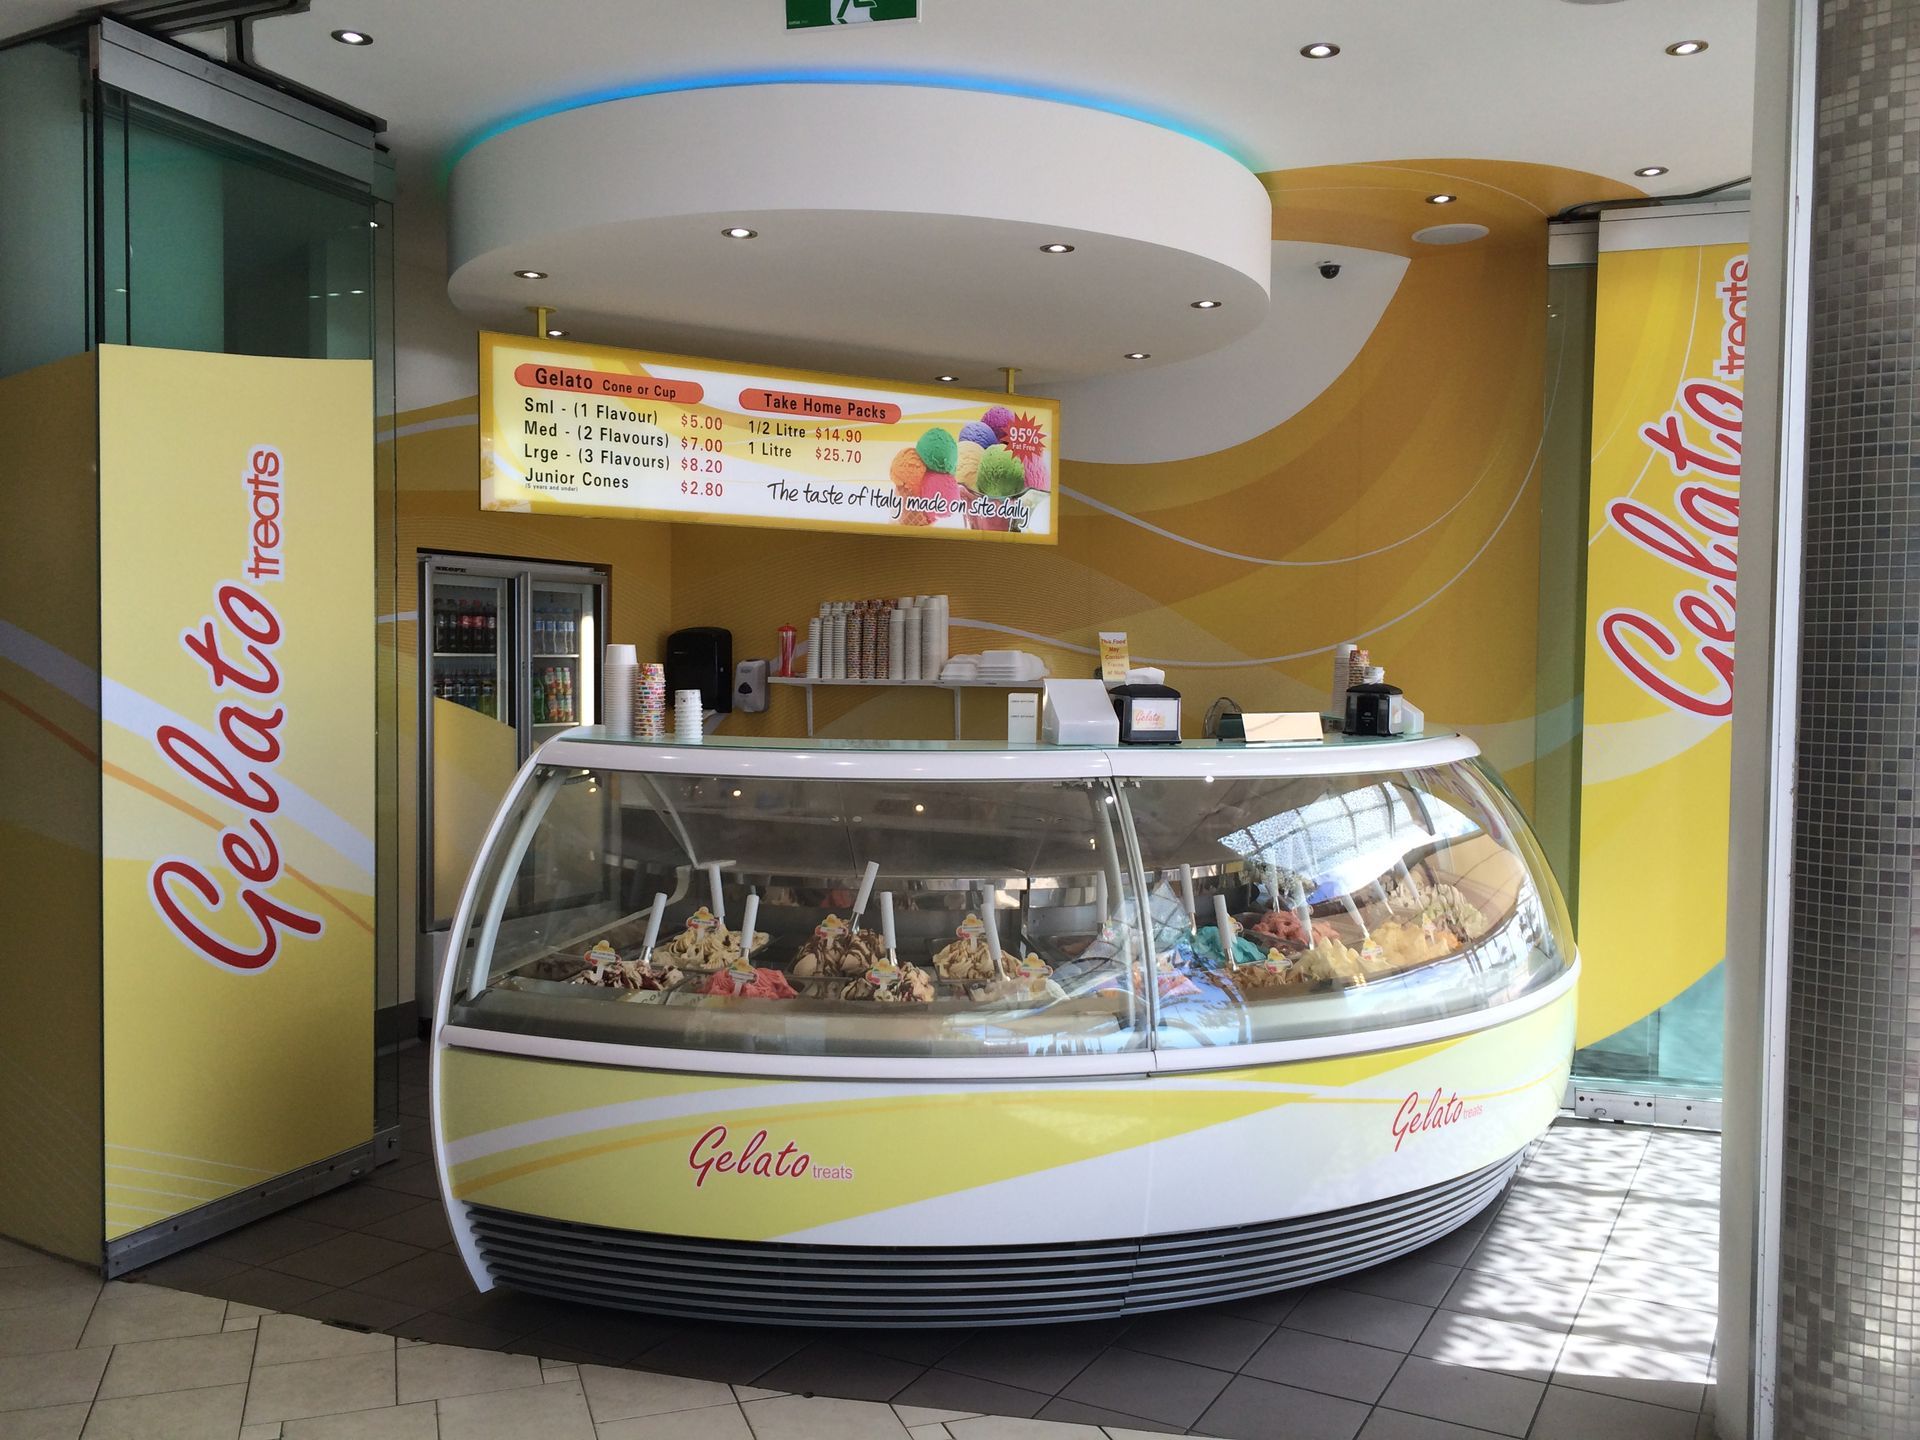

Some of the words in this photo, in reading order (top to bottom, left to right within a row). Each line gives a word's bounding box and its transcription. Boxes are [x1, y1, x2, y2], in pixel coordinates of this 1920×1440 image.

[535, 368, 593, 390] Gelato
[602, 380, 633, 393] Cone
[637, 384, 649, 395] or
[654, 385, 676, 400] Cup
[524, 397, 554, 414] Sml
[574, 402, 588, 418] (1
[596, 404, 658, 426] Flavour)
[764, 393, 797, 410] Take
[803, 397, 842, 414] Home
[848, 403, 886, 419] Packs
[681, 413, 723, 431] $5.00
[748, 420, 770, 435] 1/2
[776, 423, 806, 438] Litre
[524, 420, 557, 437] Med
[577, 425, 593, 441] (2
[600, 428, 669, 449] Flavours)
[681, 436, 723, 453] $7.00
[815, 426, 862, 443] $14.90
[1009, 426, 1039, 444] 95%
[748, 441, 754, 455] 1
[762, 442, 792, 458] Litre
[815, 446, 862, 464] $25.70
[1012, 442, 1022, 450] Fat
[524, 443, 558, 463] Lrge
[578, 448, 593, 464] (3
[601, 450, 670, 471] Flavours)
[681, 457, 723, 474] $8.20
[525, 467, 575, 485] Junior
[582, 472, 629, 489] Cones
[681, 479, 723, 497] $2.80
[767, 479, 799, 502] The
[803, 483, 844, 505] taste
[847, 486, 869, 506] of
[870, 488, 902, 519] Italy
[906, 493, 946, 513] made
[950, 500, 966, 513] on
[970, 496, 996, 516] site
[997, 499, 1029, 528] daily
[153, 585, 322, 969] Gelato
[247, 450, 280, 578] treats
[1392, 1087, 1464, 1153] Gelato
[689, 1125, 810, 1187] Gelato
[812, 1164, 853, 1180] treats
